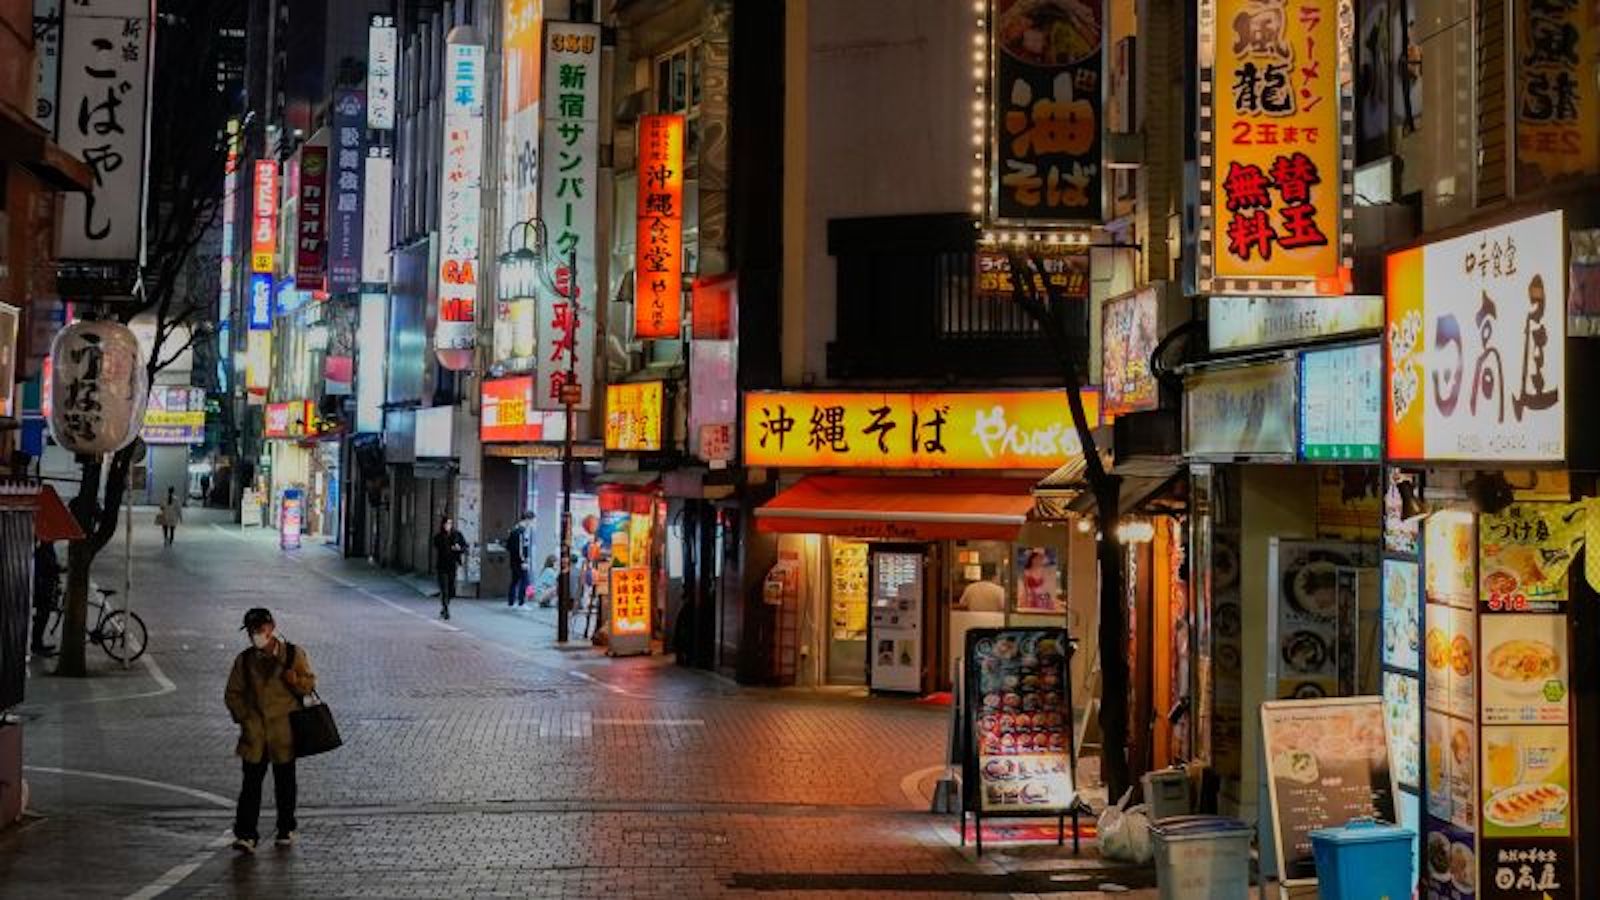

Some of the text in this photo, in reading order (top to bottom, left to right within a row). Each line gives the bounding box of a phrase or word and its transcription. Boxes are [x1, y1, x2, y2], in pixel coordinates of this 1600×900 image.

[373, 15, 393, 27] 3F
[454, 61, 475, 106] 三平
[78, 38, 133, 240] こばやし
[1231, 121, 1320, 145] 2玉まで
[645, 164, 675, 273] 沖縄食堂
[1222, 160, 1280, 261] 無料
[1269, 152, 1328, 249] 替玉
[440, 298, 475, 322] ME
[1431, 273, 1559, 424] 日高屋
[759, 405, 950, 454] 沖縄そば
[972, 404, 1082, 458] やんばる
[1494, 863, 1561, 892] 日高屋
